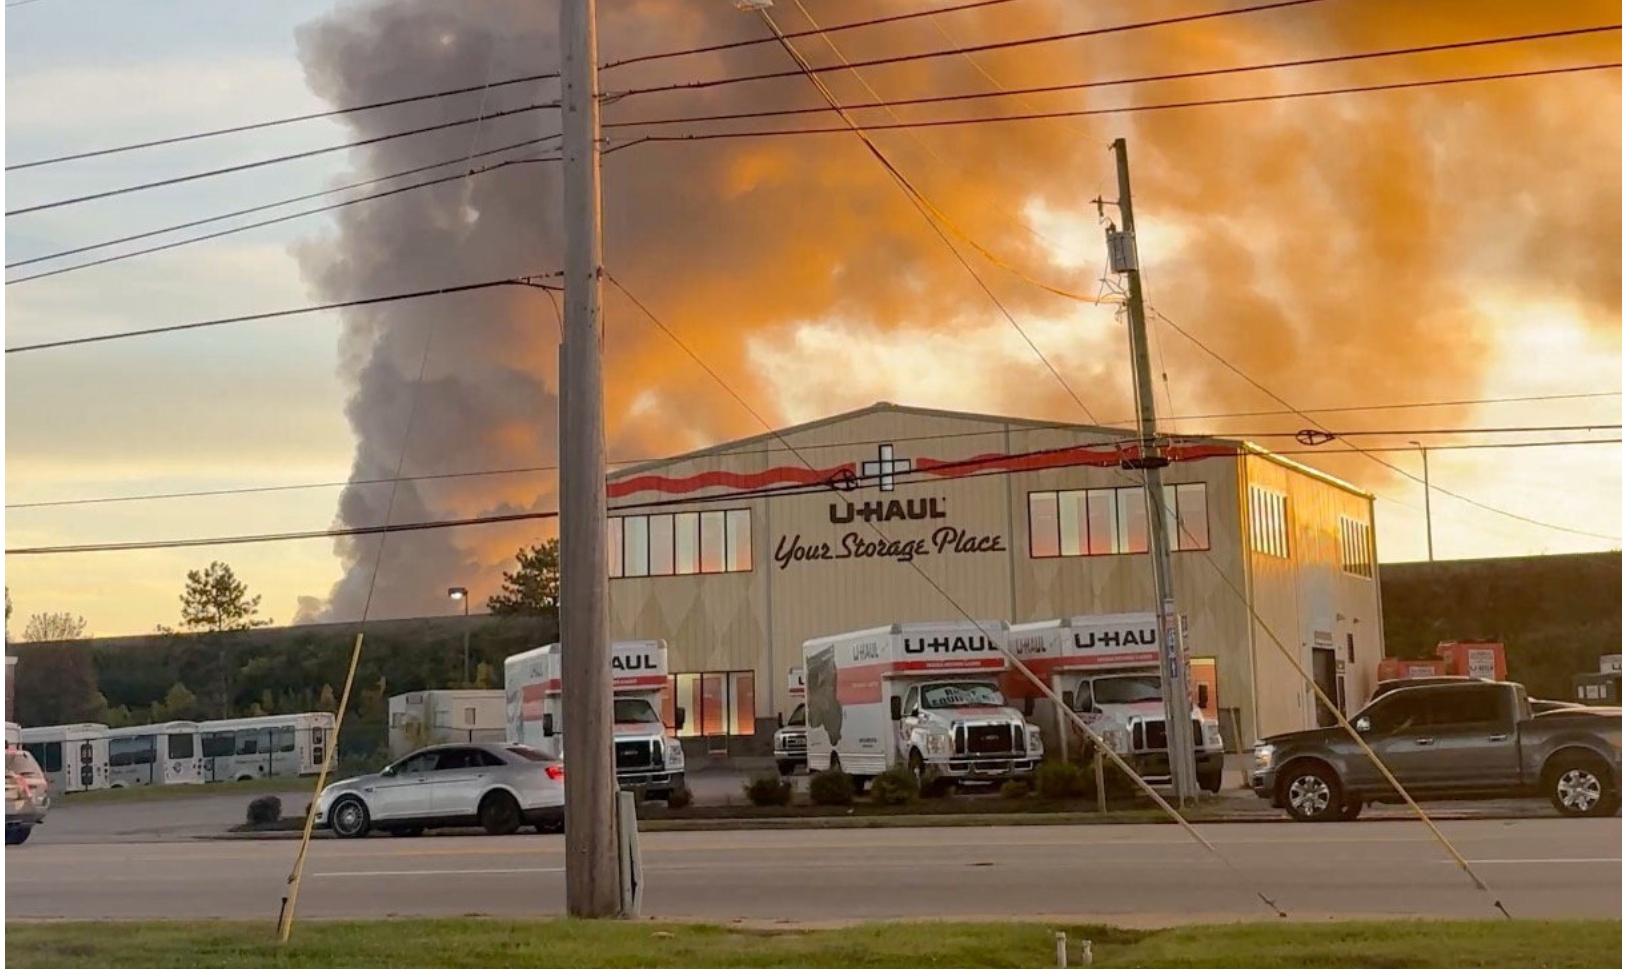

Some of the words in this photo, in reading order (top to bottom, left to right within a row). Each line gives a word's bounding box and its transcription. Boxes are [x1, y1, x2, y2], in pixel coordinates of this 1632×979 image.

[830, 497, 947, 524] U-HAUL
[774, 534, 834, 570] Your
[835, 532, 930, 562] Storage
[931, 526, 1007, 555] Place
[904, 636, 999, 654] U-HAUL
[1074, 629, 1157, 649] U-HAU
[612, 654, 657, 670] AUL
